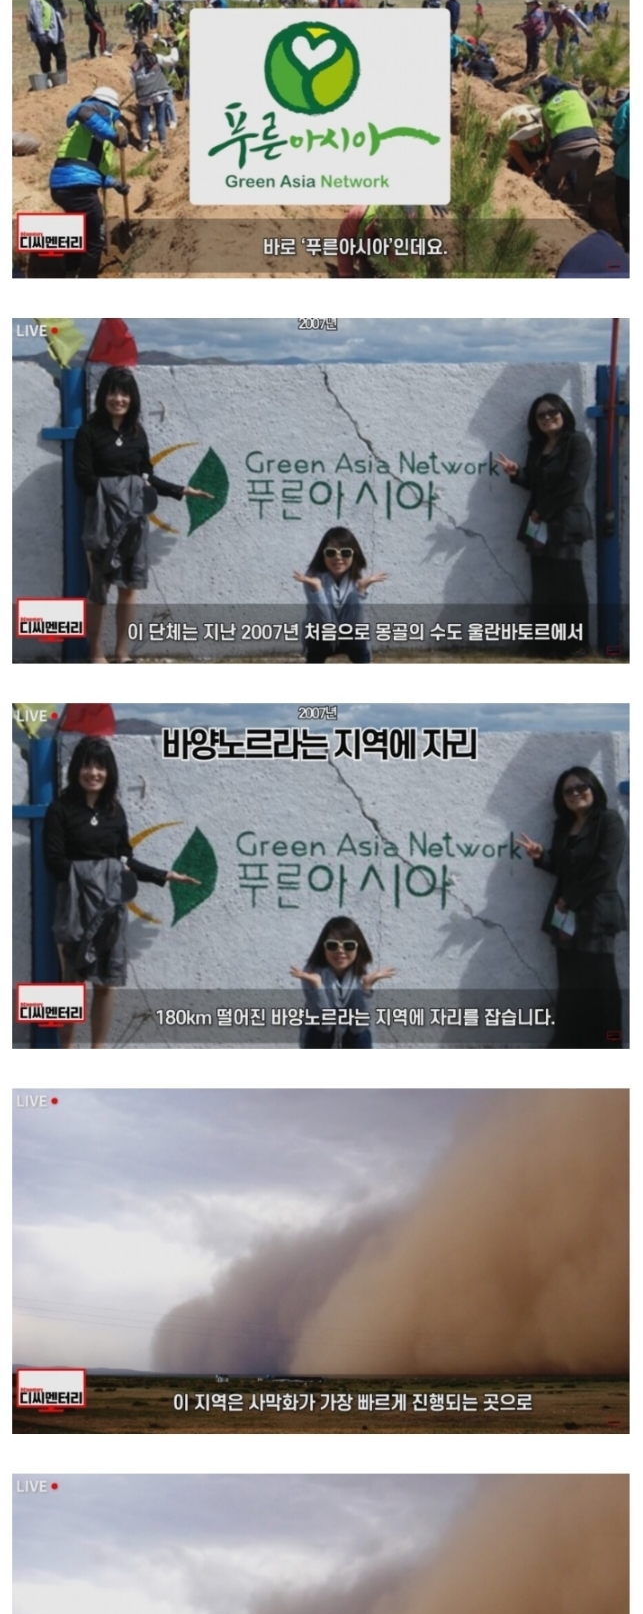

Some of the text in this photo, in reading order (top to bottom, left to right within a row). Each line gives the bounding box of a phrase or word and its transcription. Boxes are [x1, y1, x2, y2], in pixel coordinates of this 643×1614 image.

[245, 451, 499, 477] Green Asia Network
[236, 831, 522, 859] Green Asia Network
